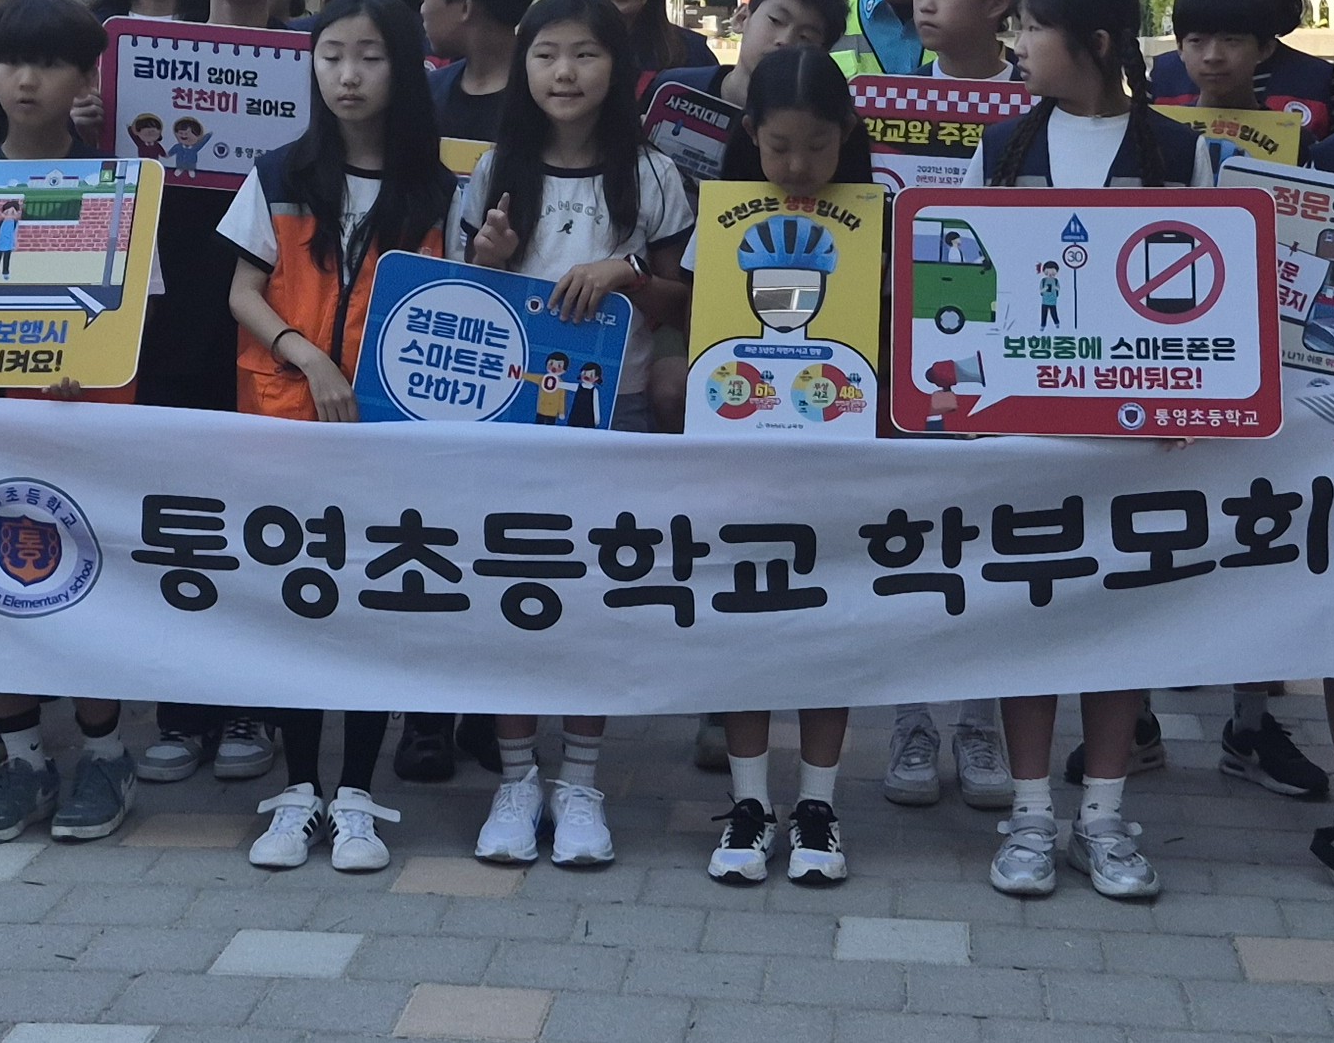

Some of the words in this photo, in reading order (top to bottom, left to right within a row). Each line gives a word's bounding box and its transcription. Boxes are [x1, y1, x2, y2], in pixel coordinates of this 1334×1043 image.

[133, 56, 200, 83] 급하지
[207, 66, 258, 88] 않아요
[171, 87, 238, 114] 천천히
[246, 97, 296, 118] 걸어요
[541, 200, 604, 225] ANGOL
[717, 196, 780, 229] 안전모는
[1067, 250, 1084, 263] 30
[406, 306, 510, 350] 걸을때는
[398, 338, 505, 381] 스마트폰
[1003, 335, 1102, 360] 보행중에
[1110, 336, 1236, 361] 스마트폰은
[407, 371, 487, 410] 안하기
[1036, 365, 1085, 390] 잠시
[1153, 408, 1260, 427] 통영초등학교
[130, 494, 829, 631] 통영초등학교
[858, 475, 1334, 617] 학부모회
[2, 591, 70, 609] Elementary
